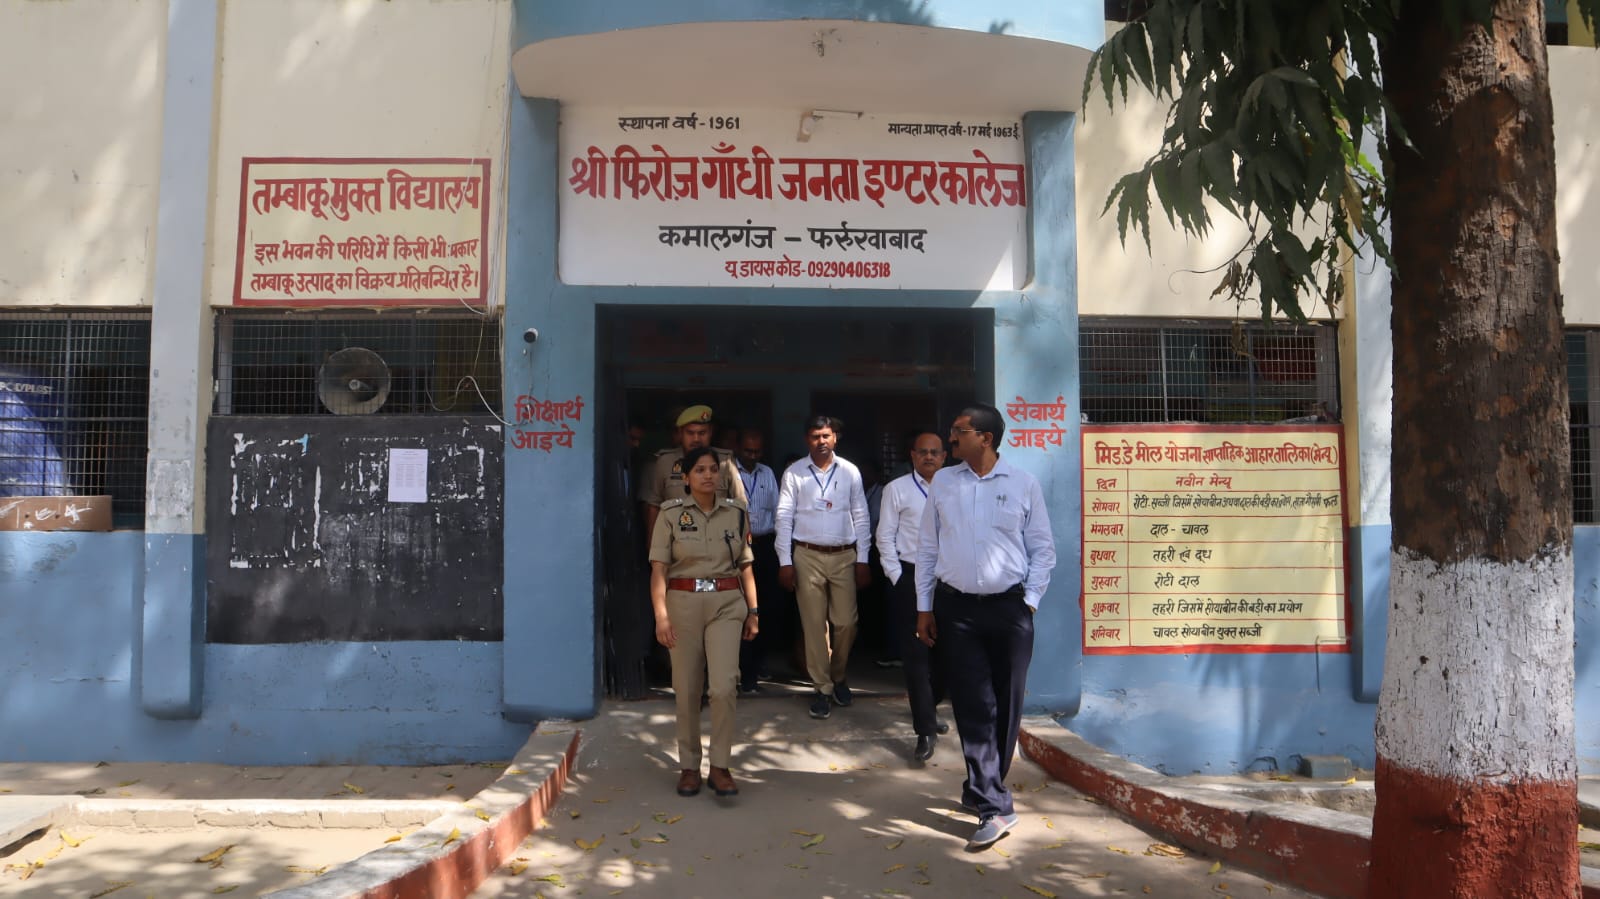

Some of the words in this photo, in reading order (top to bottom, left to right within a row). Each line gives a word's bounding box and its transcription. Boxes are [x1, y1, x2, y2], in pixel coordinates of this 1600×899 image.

[618, 116, 670, 132] स्थापना
[888, 123, 922, 136] मान्यता
[923, 124, 948, 137] प्राप्त
[569, 145, 609, 199] श्री
[610, 144, 699, 201] फिरोज़
[702, 142, 774, 200] गाँधी
[778, 158, 860, 203] जनता
[862, 160, 940, 208] इण्टर
[938, 149, 1027, 207] कालेज
[252, 178, 329, 220] तम्बाकू
[329, 178, 384, 221] मुक्त
[387, 168, 481, 214] विद्यालय
[658, 219, 777, 251] कमालगंज
[254, 243, 280, 266] इस
[282, 240, 315, 261] भवन
[315, 234, 335, 260] की
[337, 235, 376, 263] परिधि
[376, 233, 390, 260] में
[393, 234, 430, 261] किसी
[450, 238, 479, 259] प्रकार
[250, 273, 294, 297] तम्बाकू
[295, 272, 336, 294] उत्पाद
[336, 272, 353, 291] का
[355, 266, 397, 291] विक्रय
[396, 264, 460, 293] प्रतिबन्धित
[1006, 395, 1067, 423] सेवार्थ
[511, 423, 576, 454] आइये
[1007, 422, 1067, 451] जाइये
[1135, 441, 1163, 463] मील
[1164, 440, 1202, 463] योजना
[1202, 441, 1245, 464] साप्ताहिक
[1244, 446, 1275, 464] आहार
[1096, 478, 1117, 491] दिन
[1175, 473, 1205, 488] नवीन
[1209, 472, 1233, 490] मेन्यू
[1092, 498, 1120, 514] सोमवार
[1090, 521, 1124, 536] मंगलवार
[1150, 523, 1169, 538] दाल
[1181, 524, 1209, 535] चावल
[1090, 550, 1117, 566] बुधवार
[1152, 545, 1176, 563] तहरी
[1154, 572, 1174, 589] रोटी
[1178, 575, 1200, 589] दाल
[1152, 598, 1175, 616] तहरी
[1177, 598, 1204, 615] जिसमें
[1204, 598, 1237, 616] सोयाबीन
[1237, 598, 1249, 613] की
[1263, 602, 1276, 614] का
[1278, 599, 1303, 614] प्रयोग
[1090, 625, 1121, 641] शनिवार
[1153, 627, 1179, 638] चावल
[1180, 623, 1216, 639] सोयाबीन
[1238, 622, 1262, 638] सब्जी
